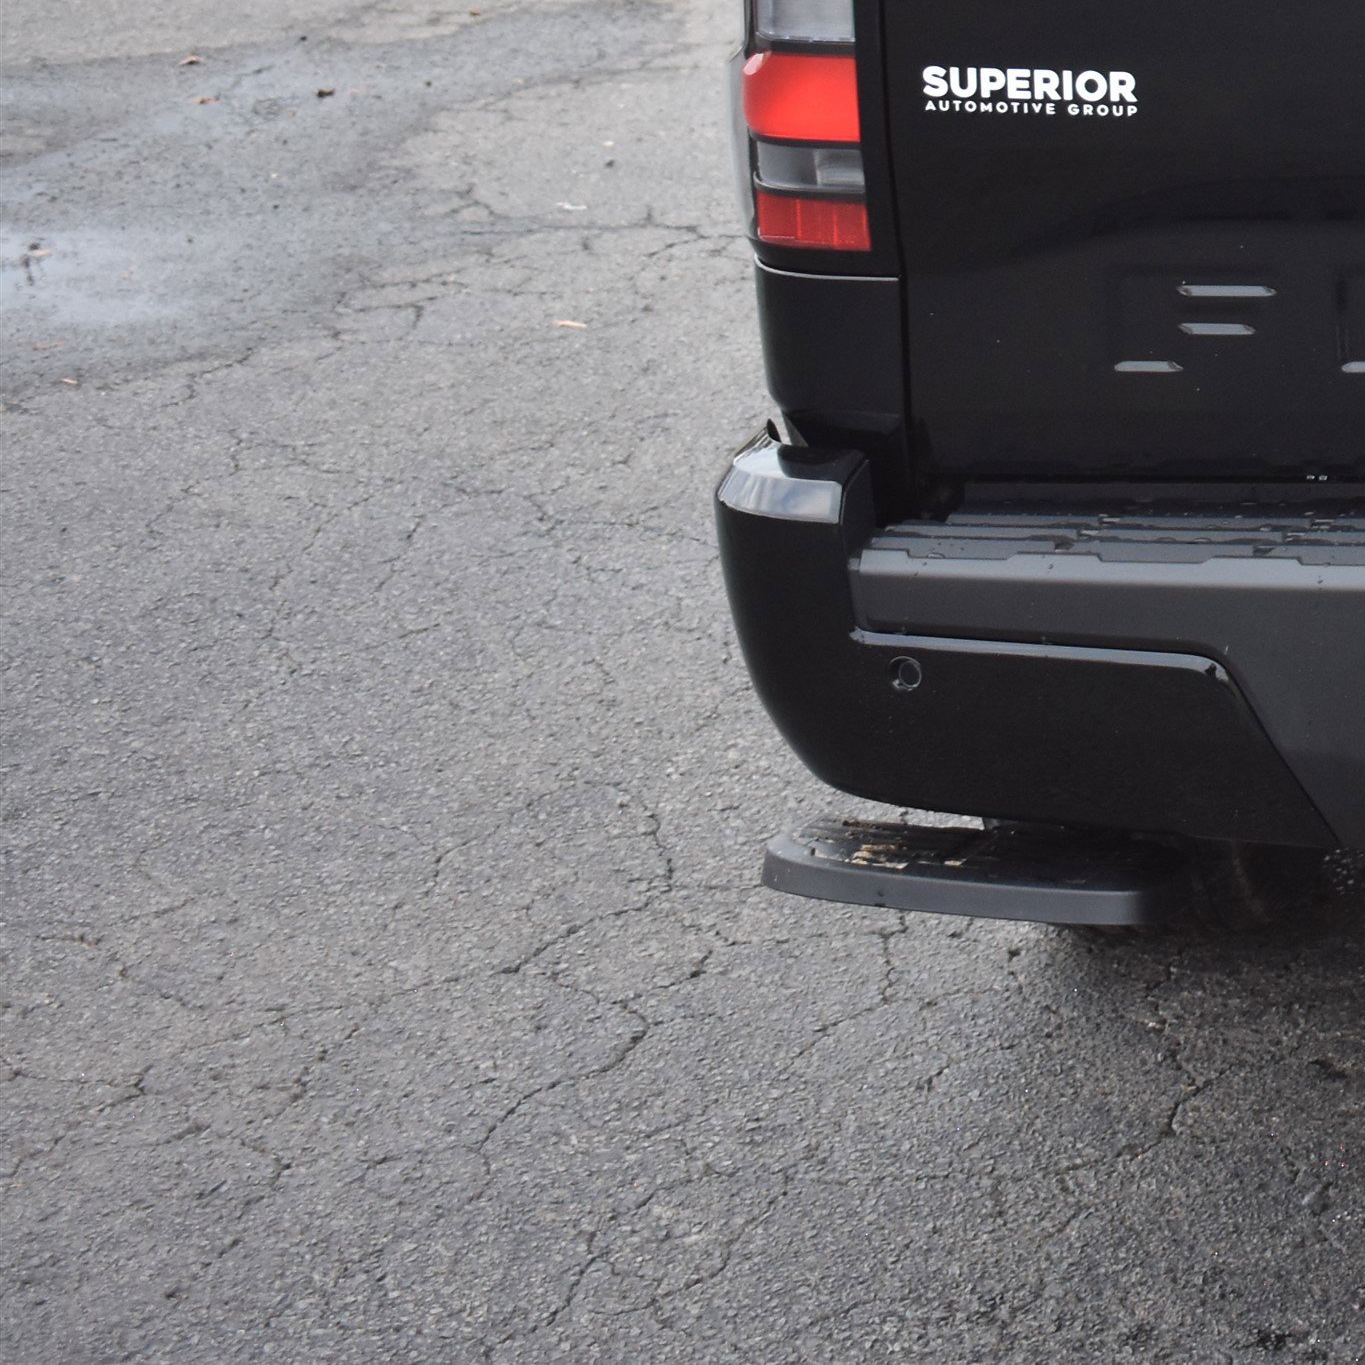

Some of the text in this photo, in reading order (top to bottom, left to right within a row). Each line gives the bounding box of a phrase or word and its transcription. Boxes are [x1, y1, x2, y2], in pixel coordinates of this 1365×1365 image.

[922, 65, 1138, 102] SUPERIOR
[925, 99, 1138, 117] AUTOMOTIVE GROUP
